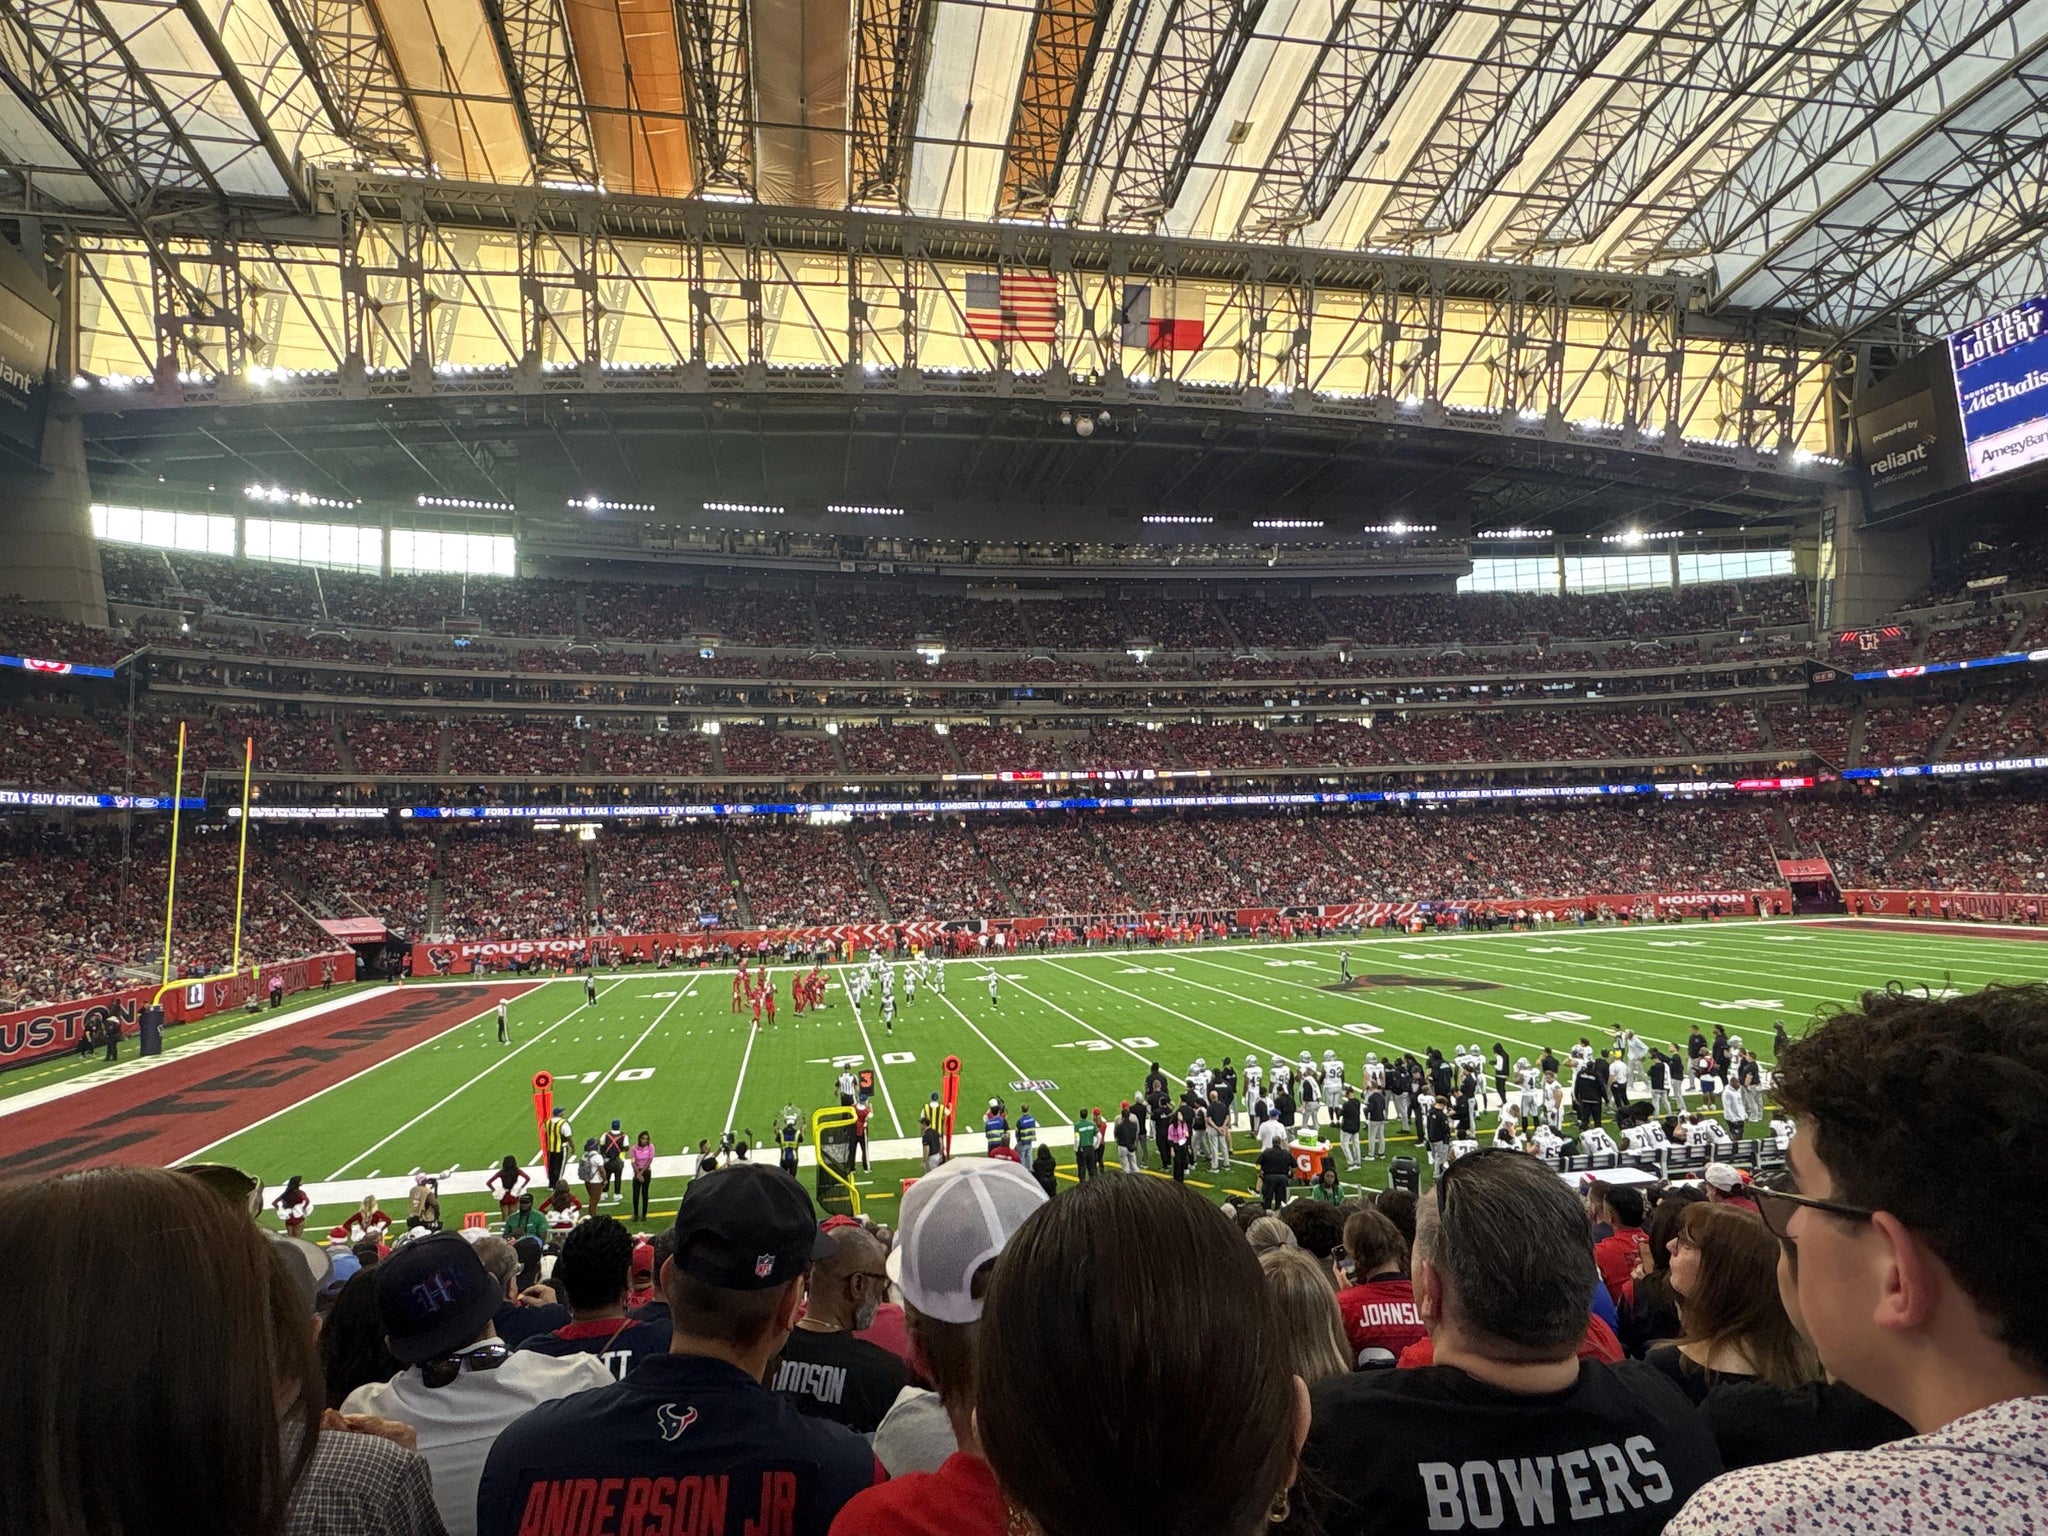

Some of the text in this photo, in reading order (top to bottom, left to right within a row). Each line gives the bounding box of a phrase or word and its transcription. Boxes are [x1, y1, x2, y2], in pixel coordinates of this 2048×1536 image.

[1973, 310, 2021, 340] TEXAS
[1962, 313, 2040, 363] LOTTERY
[1964, 382, 2000, 400] HOUSTON
[1872, 420, 1919, 444] powered by
[1870, 444, 1927, 476] reliant
[1932, 764, 1961, 774] FORD
[1964, 763, 1977, 772] ES
[1980, 761, 1993, 771] LO
[1996, 758, 2032, 769] MEJOR
[21, 793, 30, 804] Y
[32, 793, 54, 805] SUV
[56, 794, 100, 806] OFICIAL
[486, 807, 510, 816] FORD
[513, 807, 523, 816] ES
[526, 807, 537, 816] LO
[1658, 894, 1745, 904] HOUSTON
[462, 940, 586, 956] HOUSTON
[1075, 1037, 1160, 1051] 30
[832, 1052, 916, 1068] 20
[580, 1067, 656, 1084] 10
[860, 1072, 872, 1088] 3
[1592, 1133, 1612, 1151] 76
[1296, 1154, 1312, 1172] G
[467, 1215, 482, 1229] 10
[1418, 1435, 1674, 1532] BOWERS
[518, 1471, 797, 1536] ANDERSON JR
